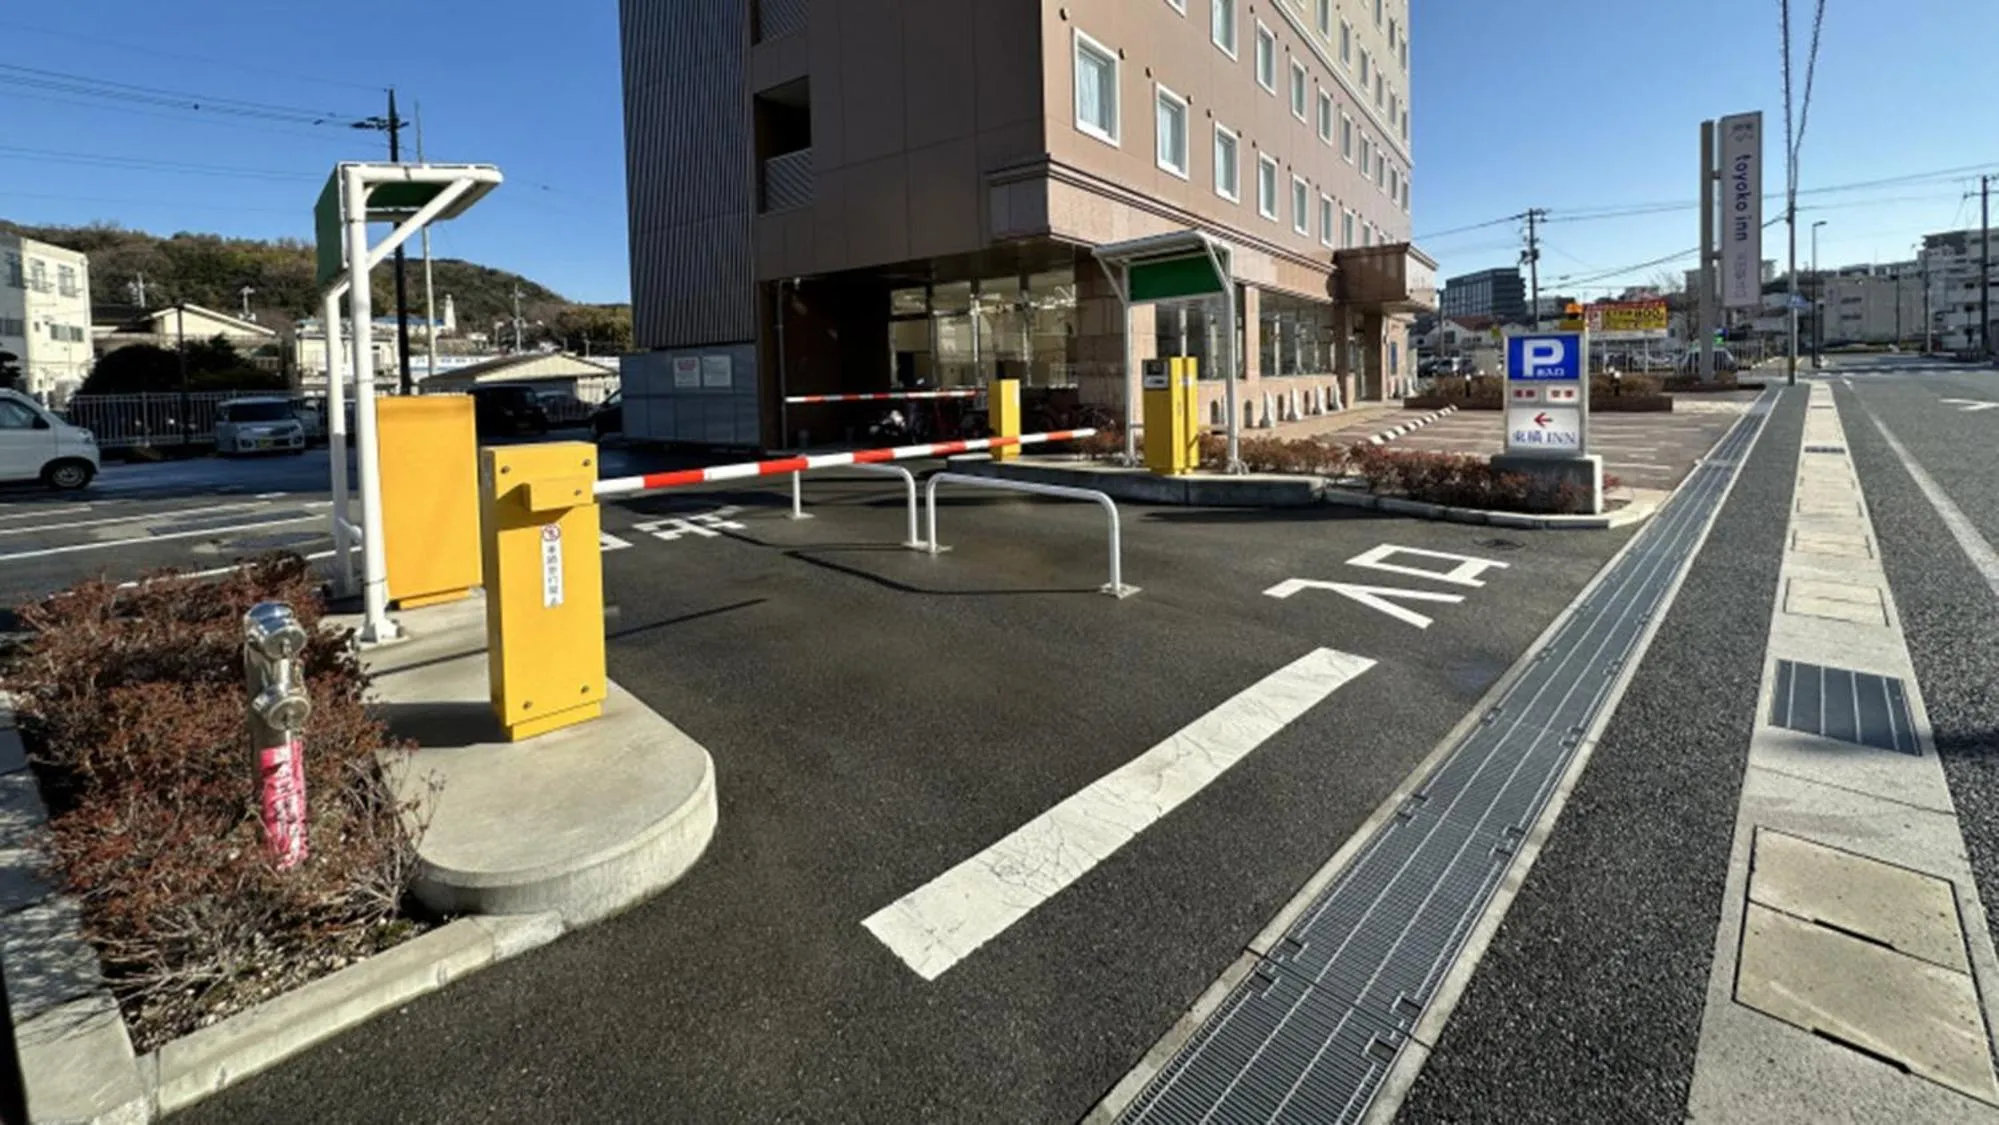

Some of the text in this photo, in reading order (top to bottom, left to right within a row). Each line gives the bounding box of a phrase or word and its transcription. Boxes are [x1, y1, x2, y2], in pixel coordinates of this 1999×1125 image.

[1732, 154, 1752, 211] toyoko
[1734, 217, 1752, 242] inn
[1522, 339, 1565, 377] P
[1262, 543, 1512, 629] 入口
